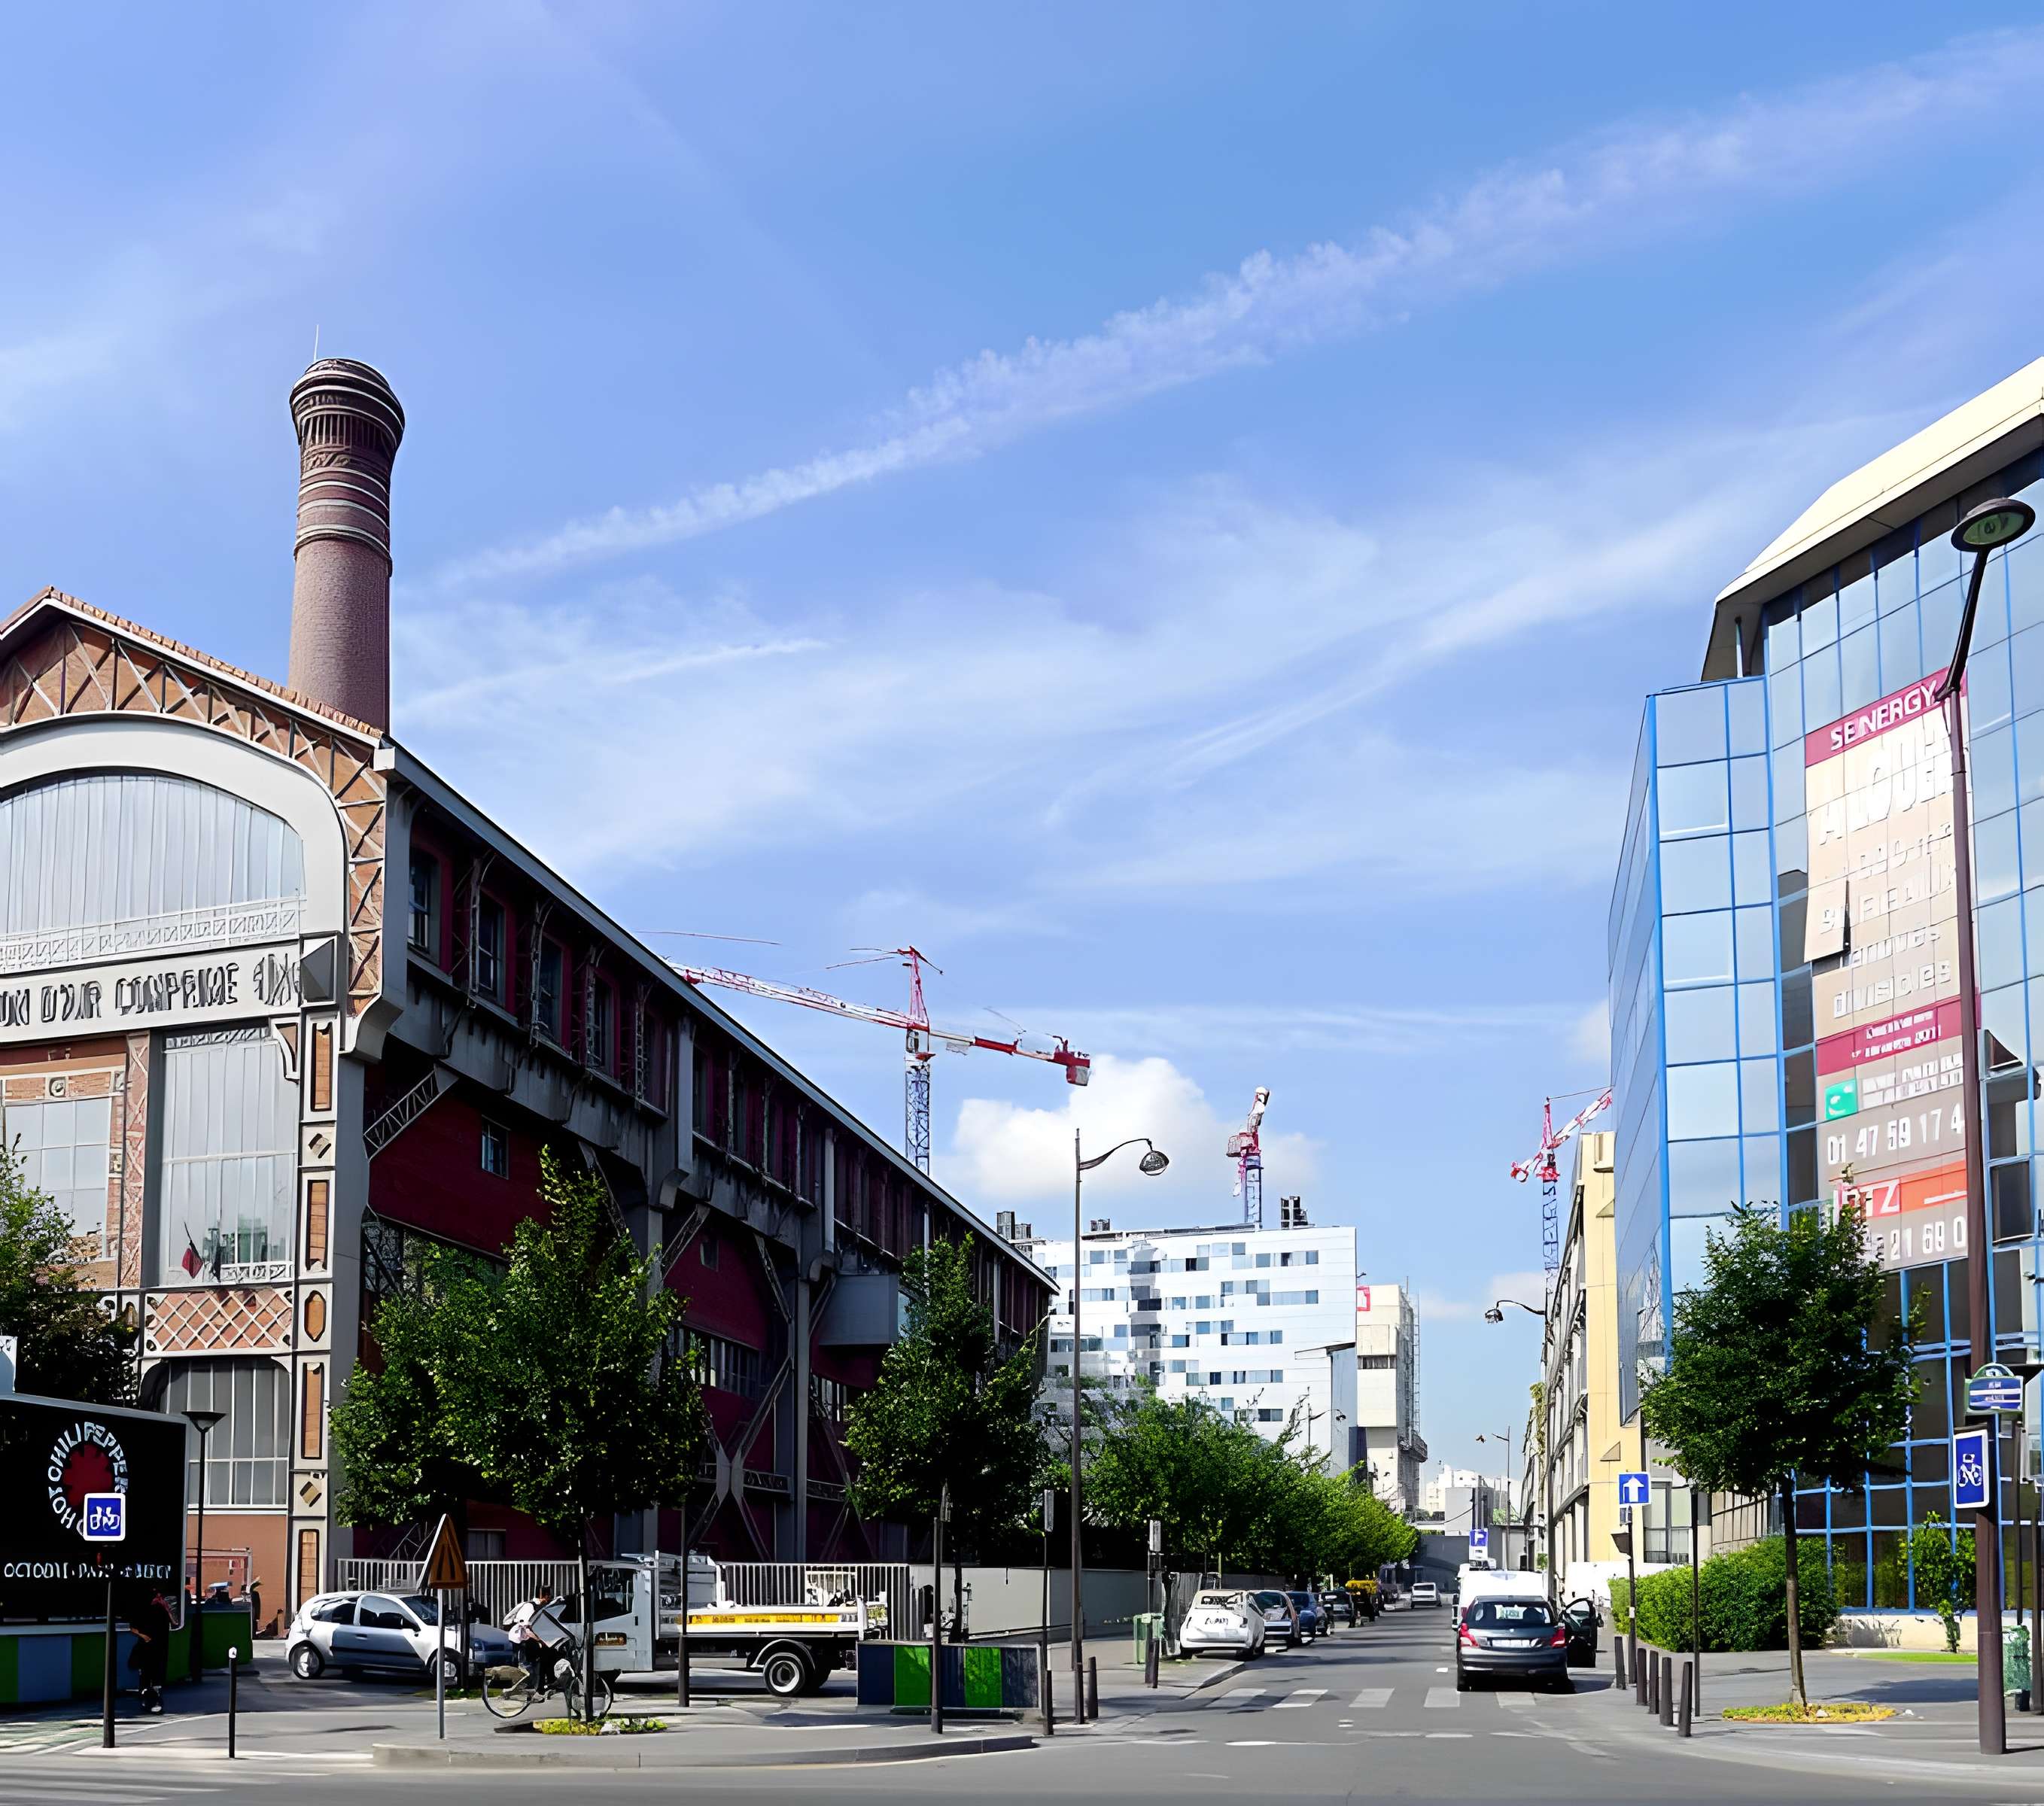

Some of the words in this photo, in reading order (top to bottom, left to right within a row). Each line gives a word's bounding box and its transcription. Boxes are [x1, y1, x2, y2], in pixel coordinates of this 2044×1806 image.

[1827, 1134, 1846, 1165] 01
[1855, 1124, 1878, 1158] 47
[1921, 1108, 1941, 1144] 17
[1890, 1227, 1912, 1261] 21
